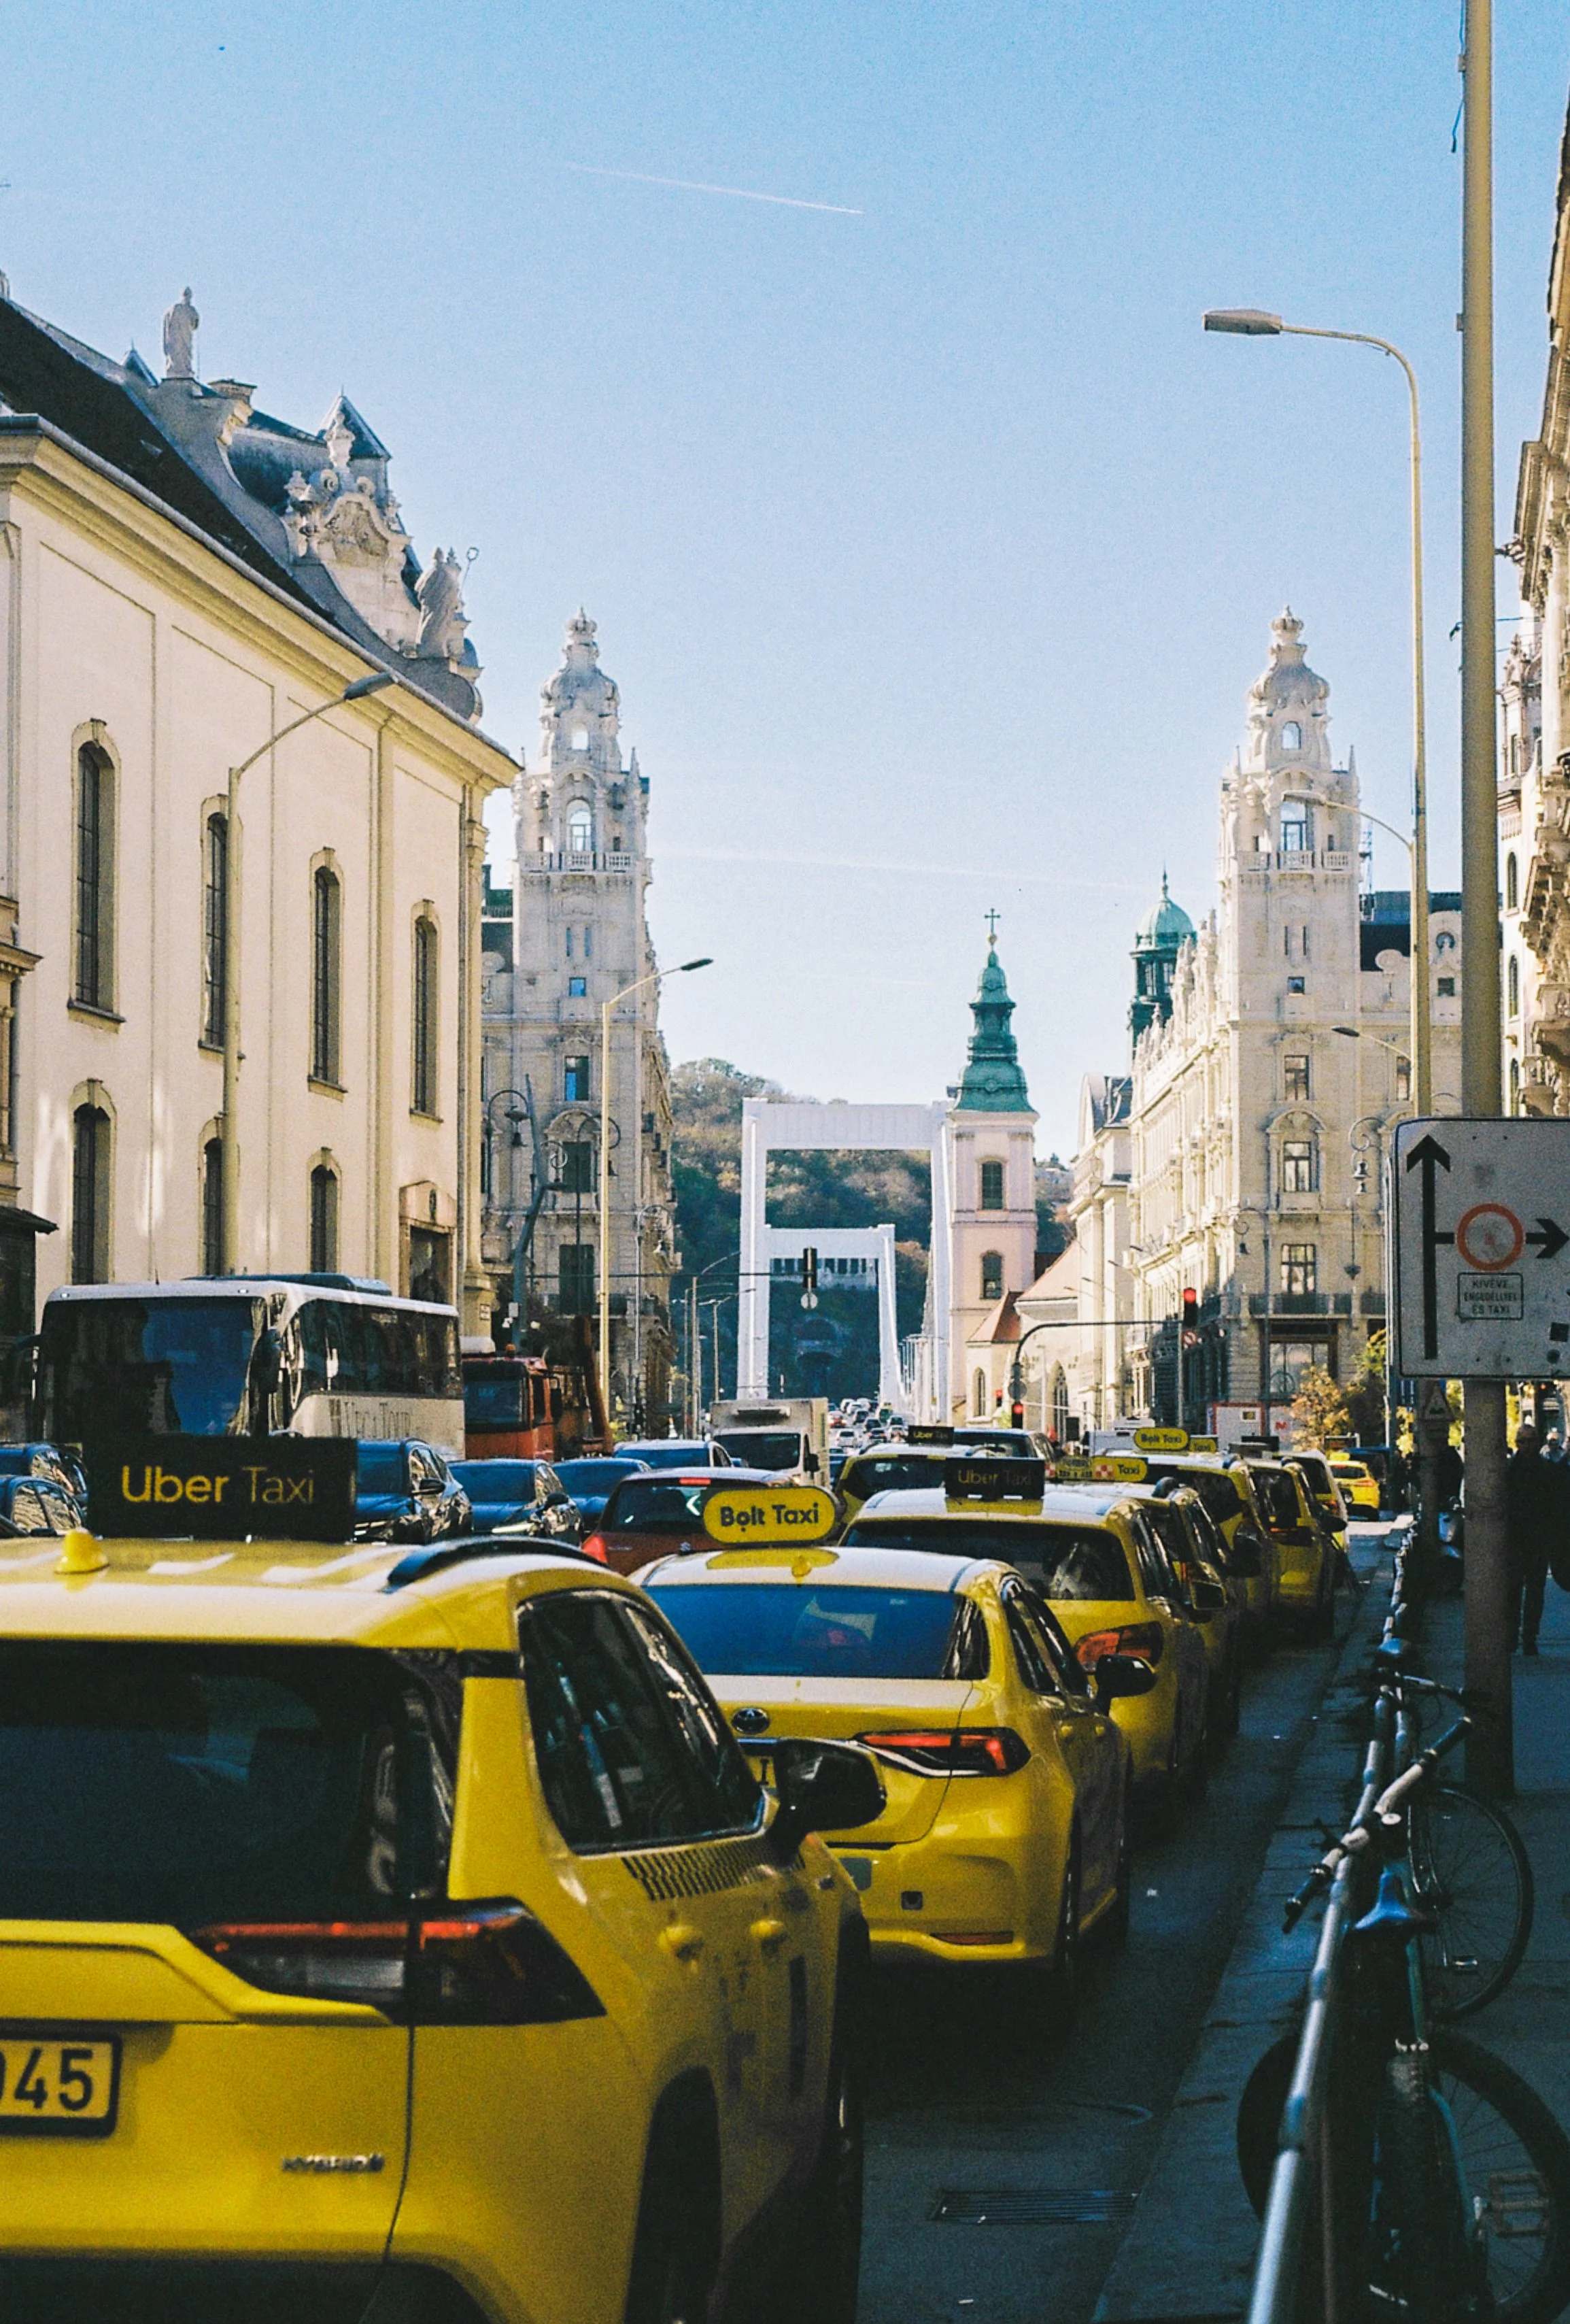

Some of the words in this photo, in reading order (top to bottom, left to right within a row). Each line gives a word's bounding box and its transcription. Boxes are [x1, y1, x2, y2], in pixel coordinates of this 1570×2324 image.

[1140, 1433, 1160, 1445] Bolt
[1163, 1433, 1182, 1443] Taxi
[958, 1468, 999, 1485] Uber
[1003, 1470, 1031, 1486] Taxi
[1116, 1464, 1140, 1475] Taxi
[122, 1466, 230, 1503] Uber
[241, 1466, 315, 1504] Taxi
[720, 1505, 766, 1532] Bolt
[772, 1502, 819, 1524] Taxi
